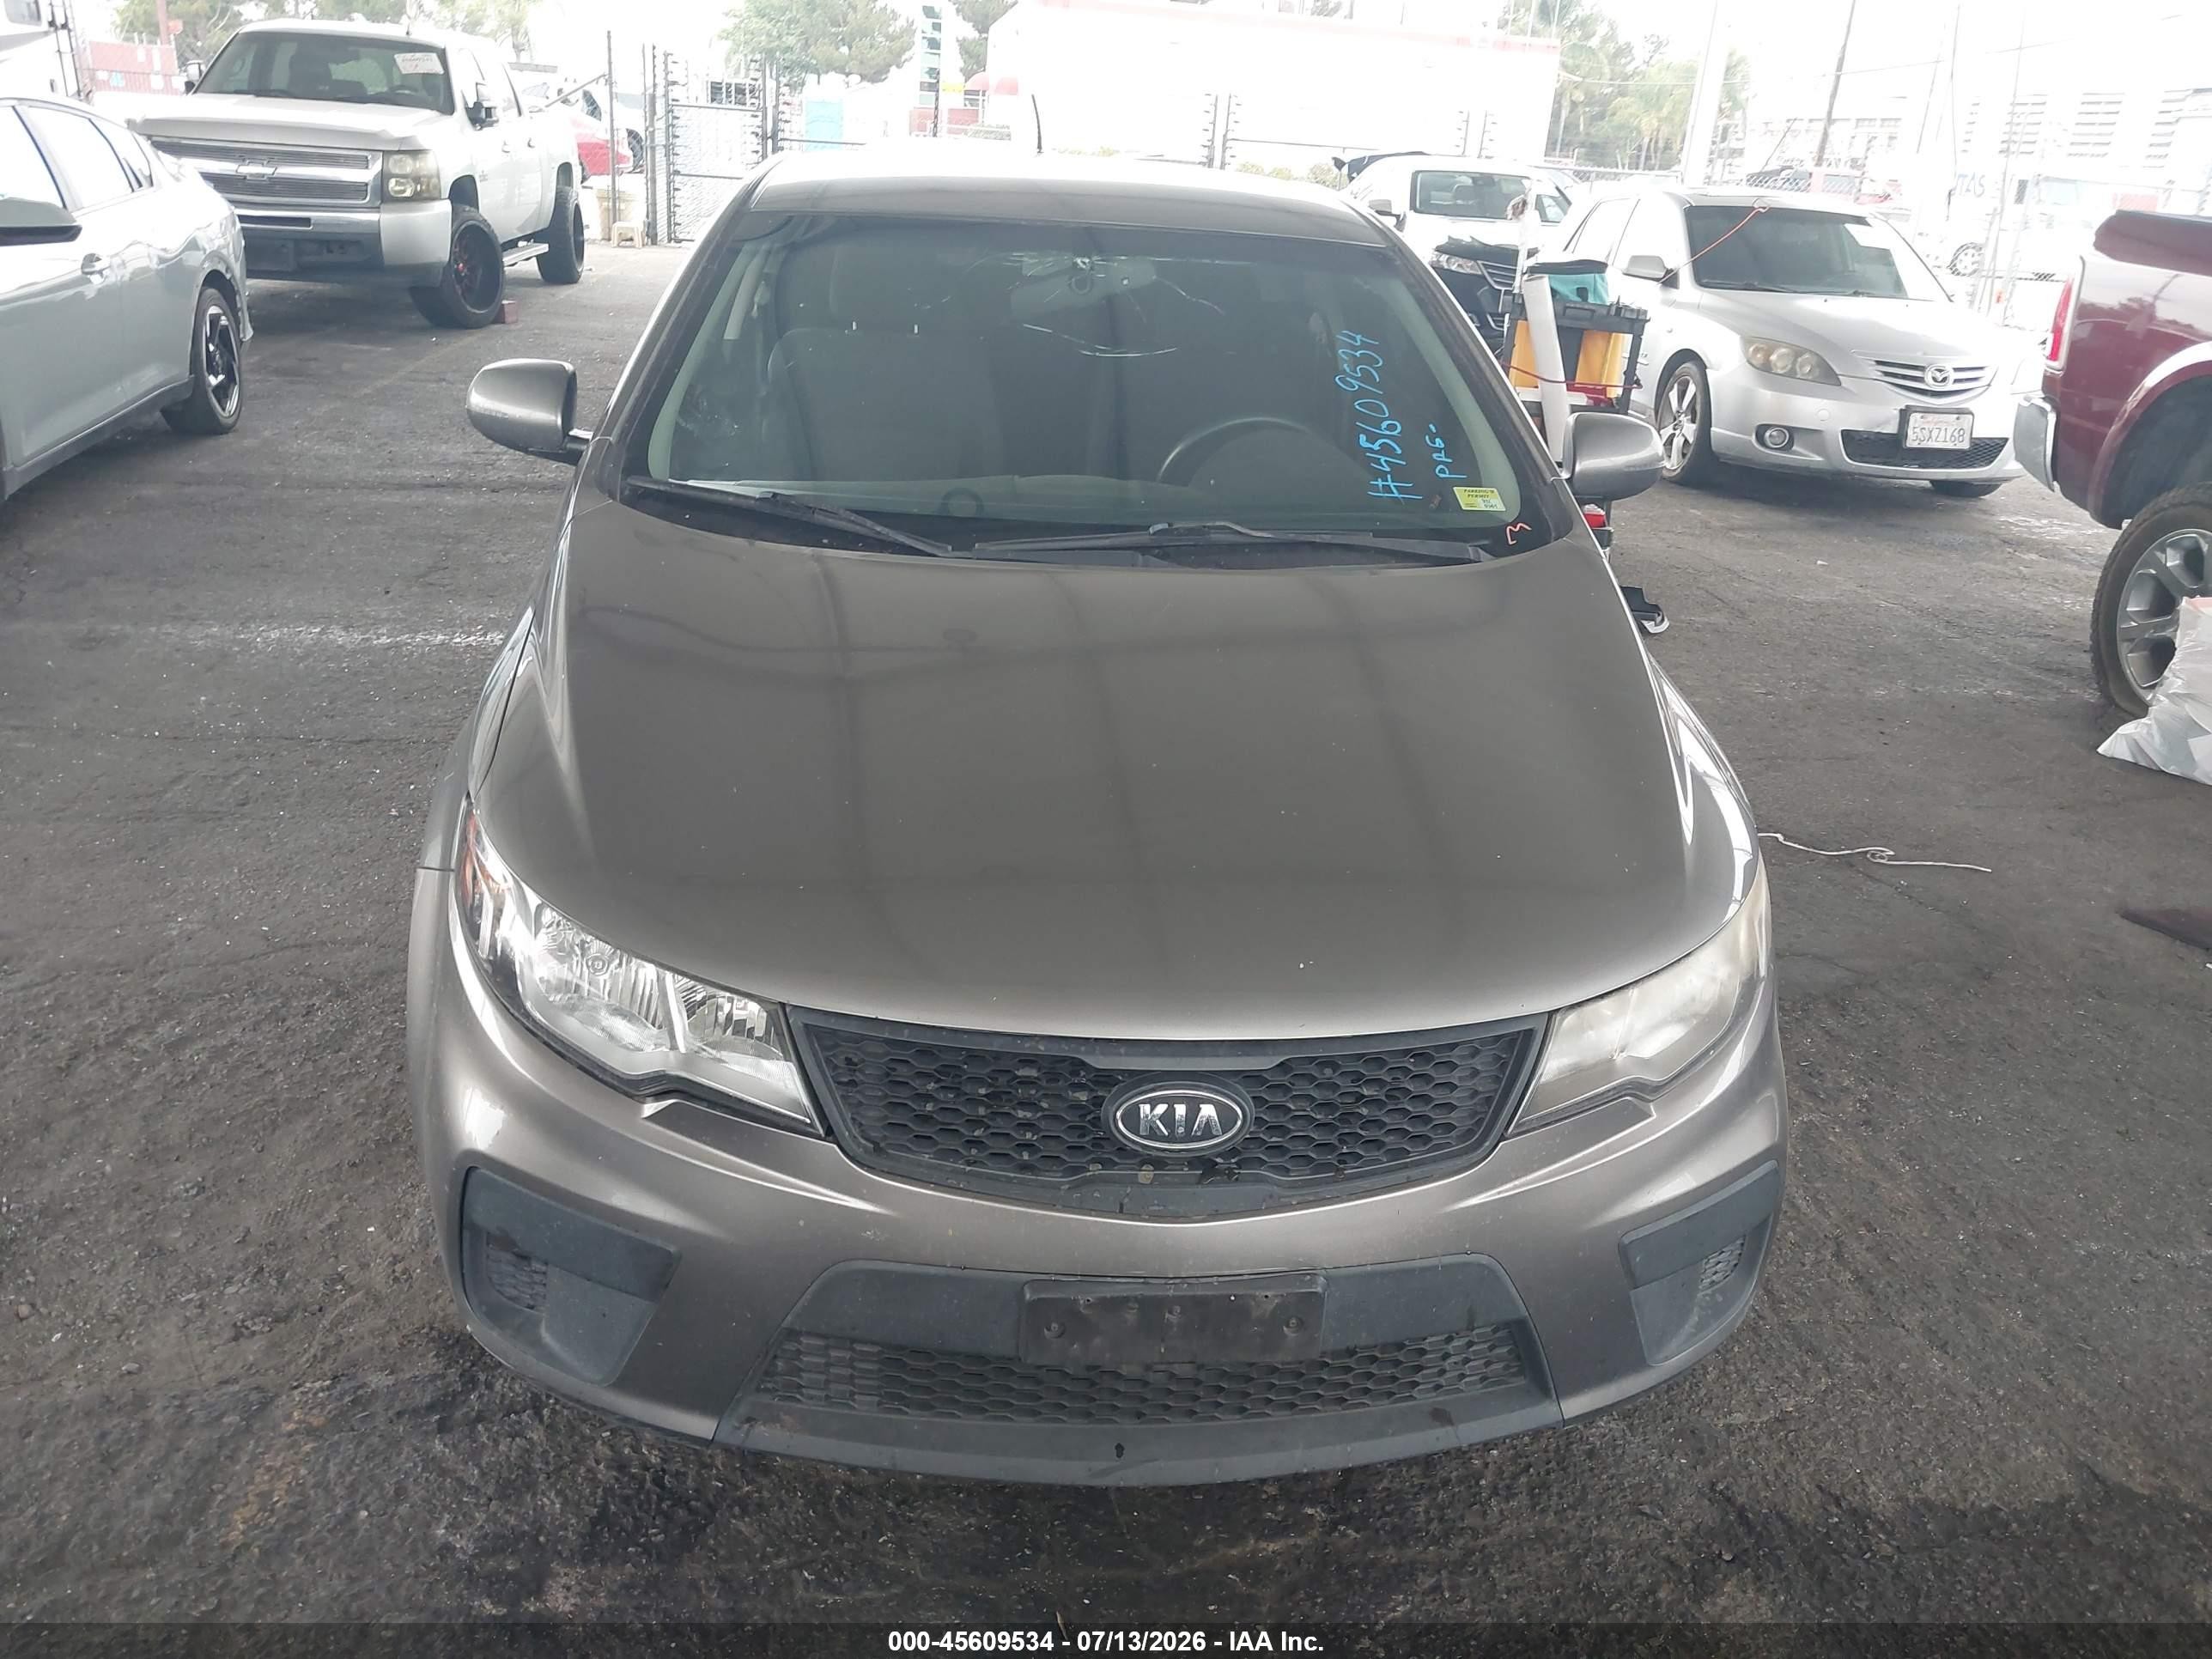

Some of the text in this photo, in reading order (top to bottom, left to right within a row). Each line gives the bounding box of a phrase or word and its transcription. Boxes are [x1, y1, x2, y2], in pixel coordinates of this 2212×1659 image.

[1334, 330, 1423, 505] #45609534
[1911, 426, 1966, 443] 5SXZ168
[1139, 1103, 1223, 1137] KIA
